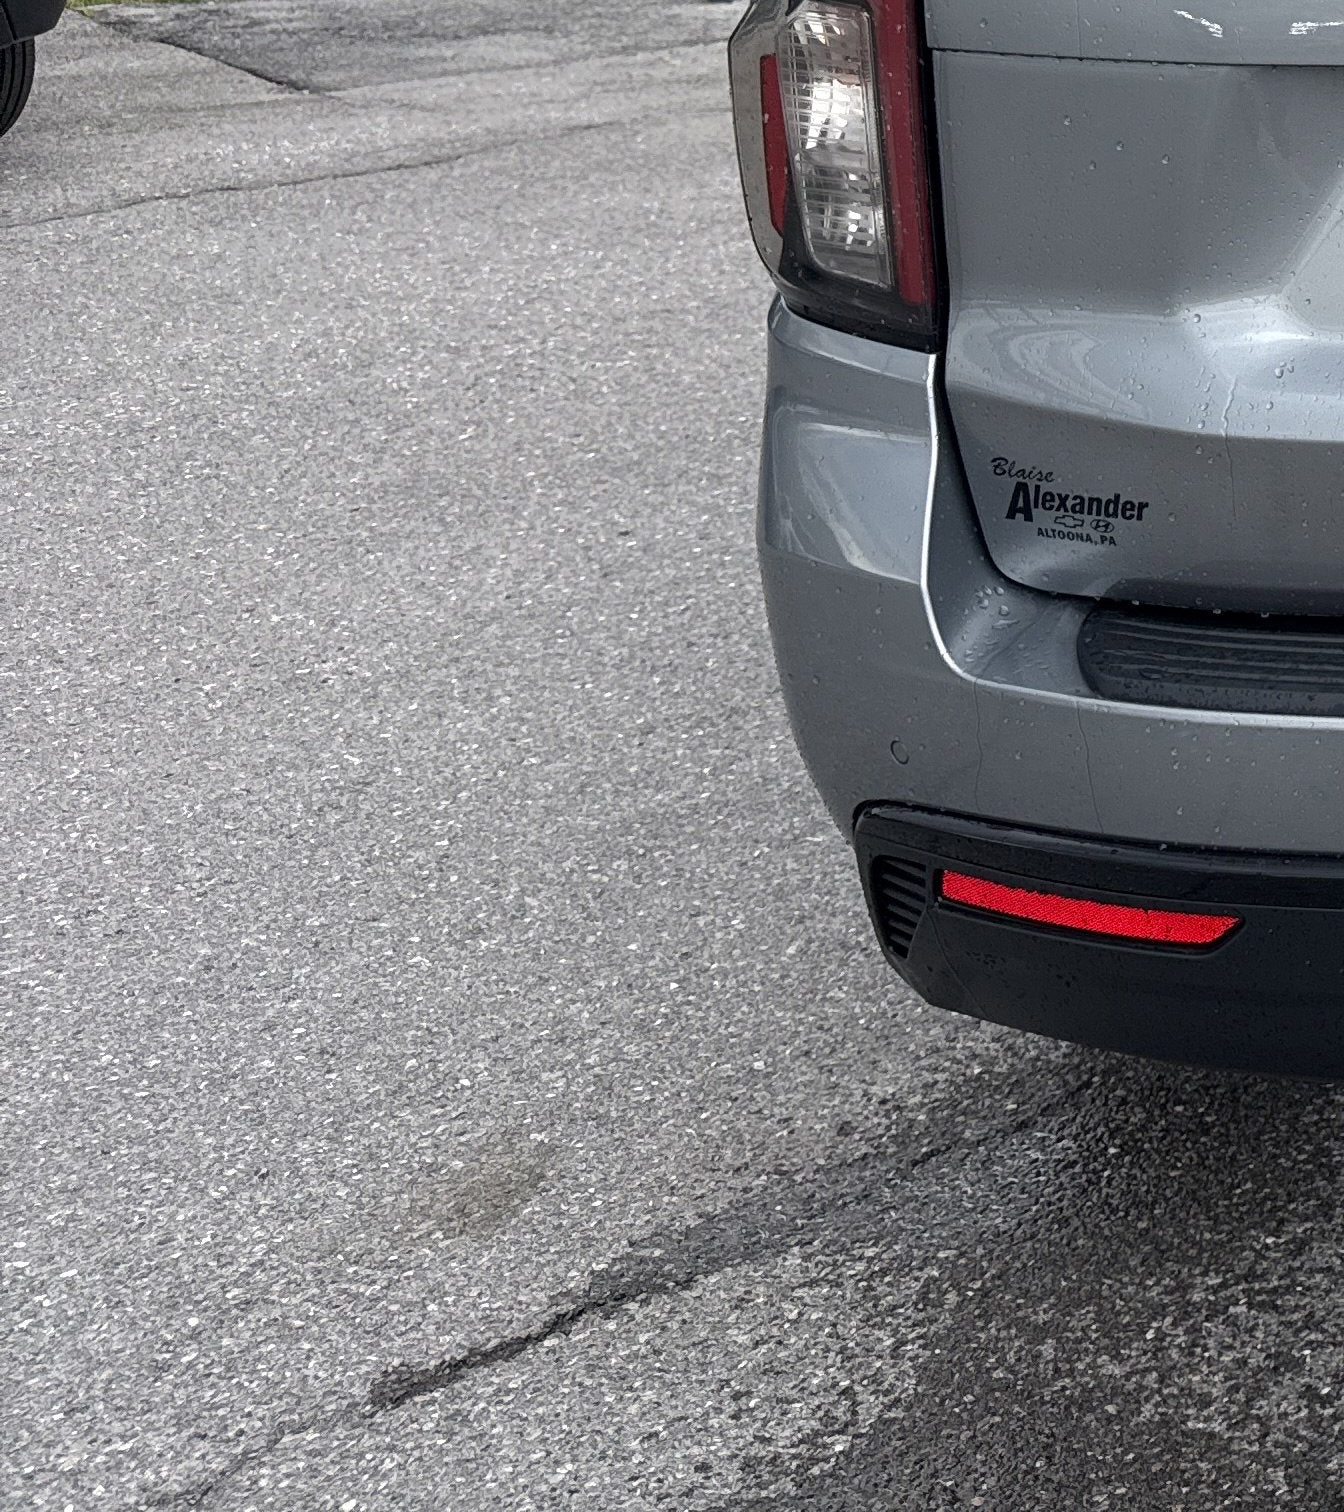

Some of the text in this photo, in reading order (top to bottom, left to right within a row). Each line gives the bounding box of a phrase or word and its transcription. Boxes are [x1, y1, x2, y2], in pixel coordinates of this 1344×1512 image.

[990, 456, 1055, 483] Blaise
[1005, 481, 1149, 522] Alexander
[1100, 534, 1117, 547] PA
